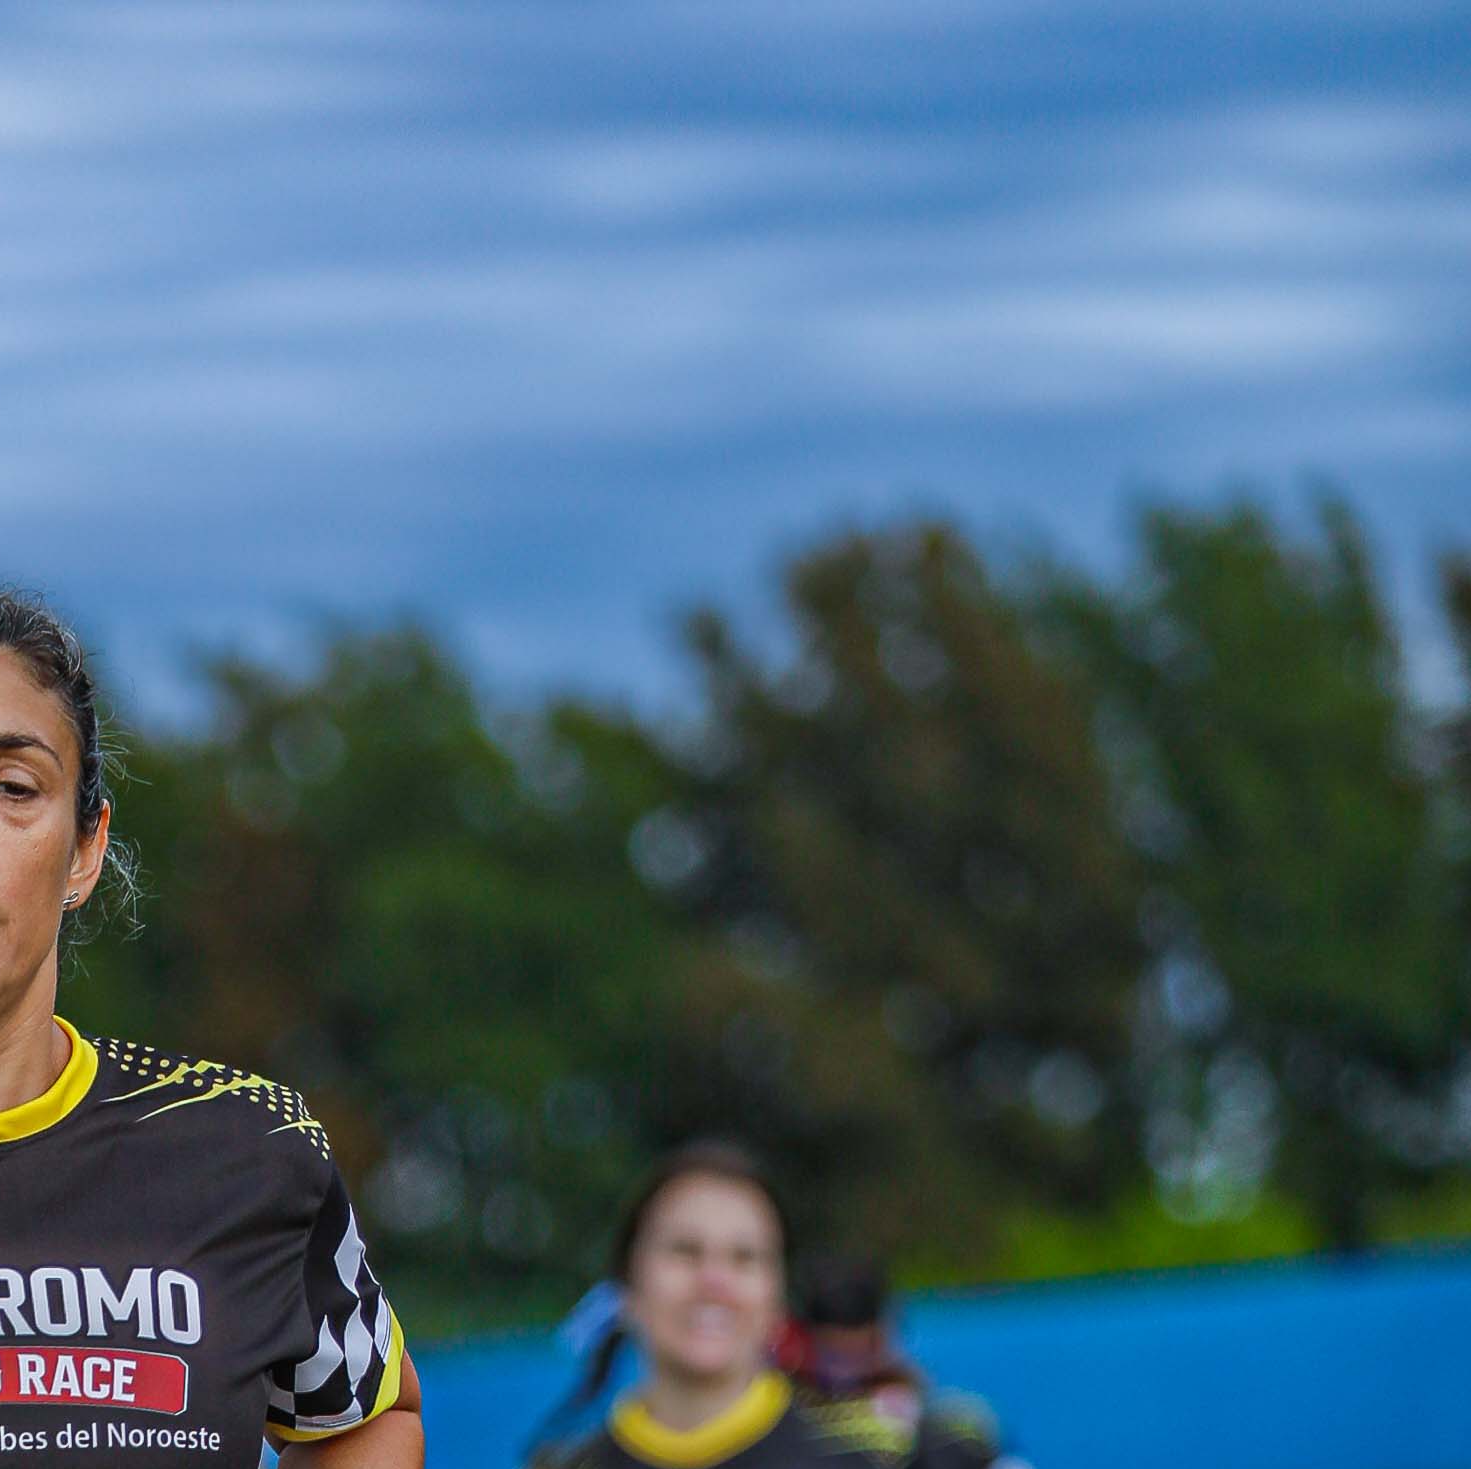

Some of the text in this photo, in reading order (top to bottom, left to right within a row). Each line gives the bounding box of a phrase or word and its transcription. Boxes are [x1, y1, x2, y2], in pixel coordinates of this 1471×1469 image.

[18, 1354, 137, 1403] RACE
[56, 1423, 99, 1449] del
[107, 1422, 221, 1451] Noroeste
